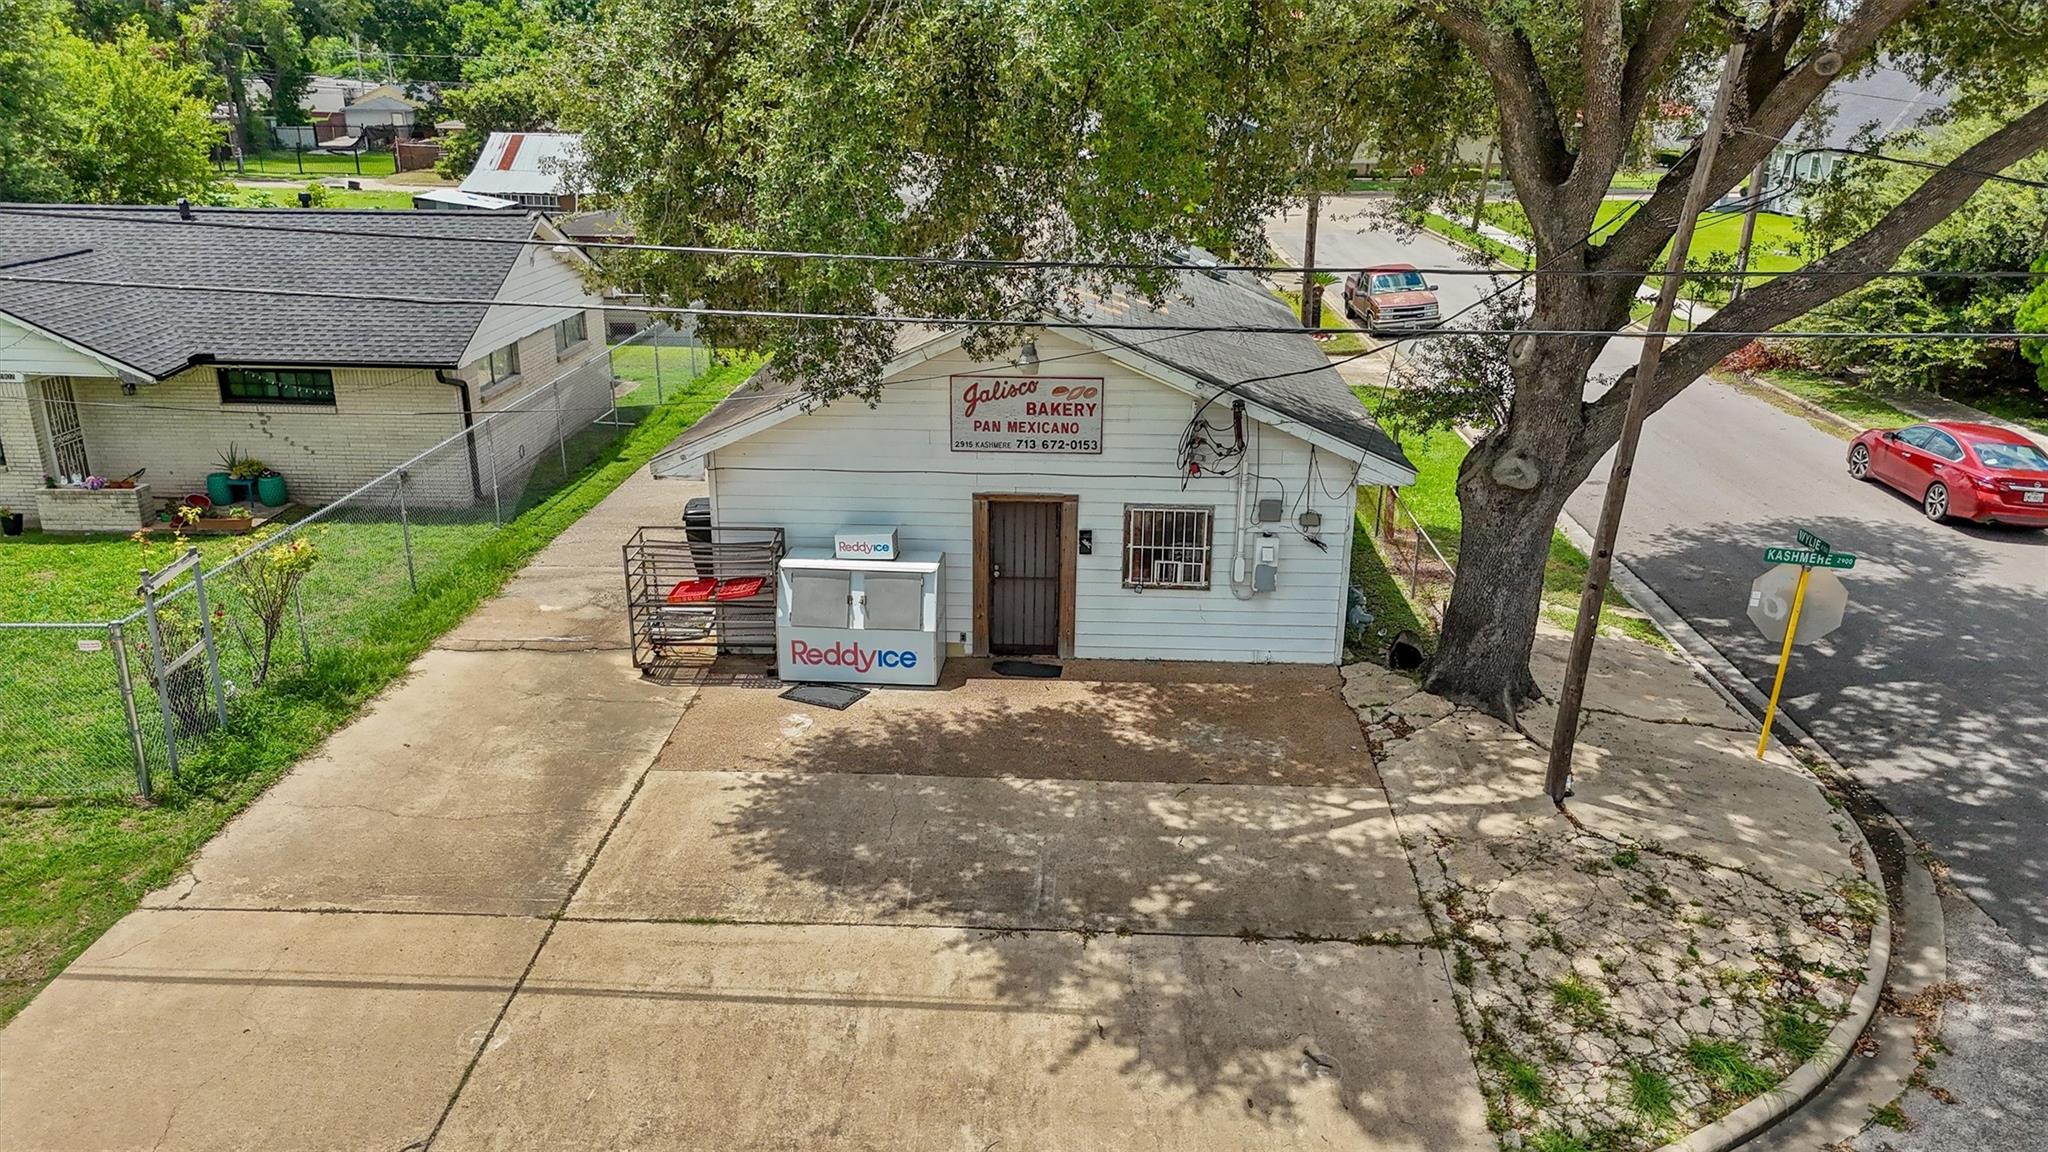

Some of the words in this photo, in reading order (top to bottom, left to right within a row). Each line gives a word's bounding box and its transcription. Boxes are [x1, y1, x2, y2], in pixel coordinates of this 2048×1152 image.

[963, 380, 1039, 418] Jalisco
[1026, 402, 1097, 417] BAKERY
[974, 420, 1001, 432] PAN
[1007, 421, 1080, 434] MEXICANO
[975, 441, 1011, 449] KASHMERE
[1016, 439, 1036, 449] 713
[1042, 440, 1098, 450] 672-0153
[1798, 529, 1821, 551] WYLIE
